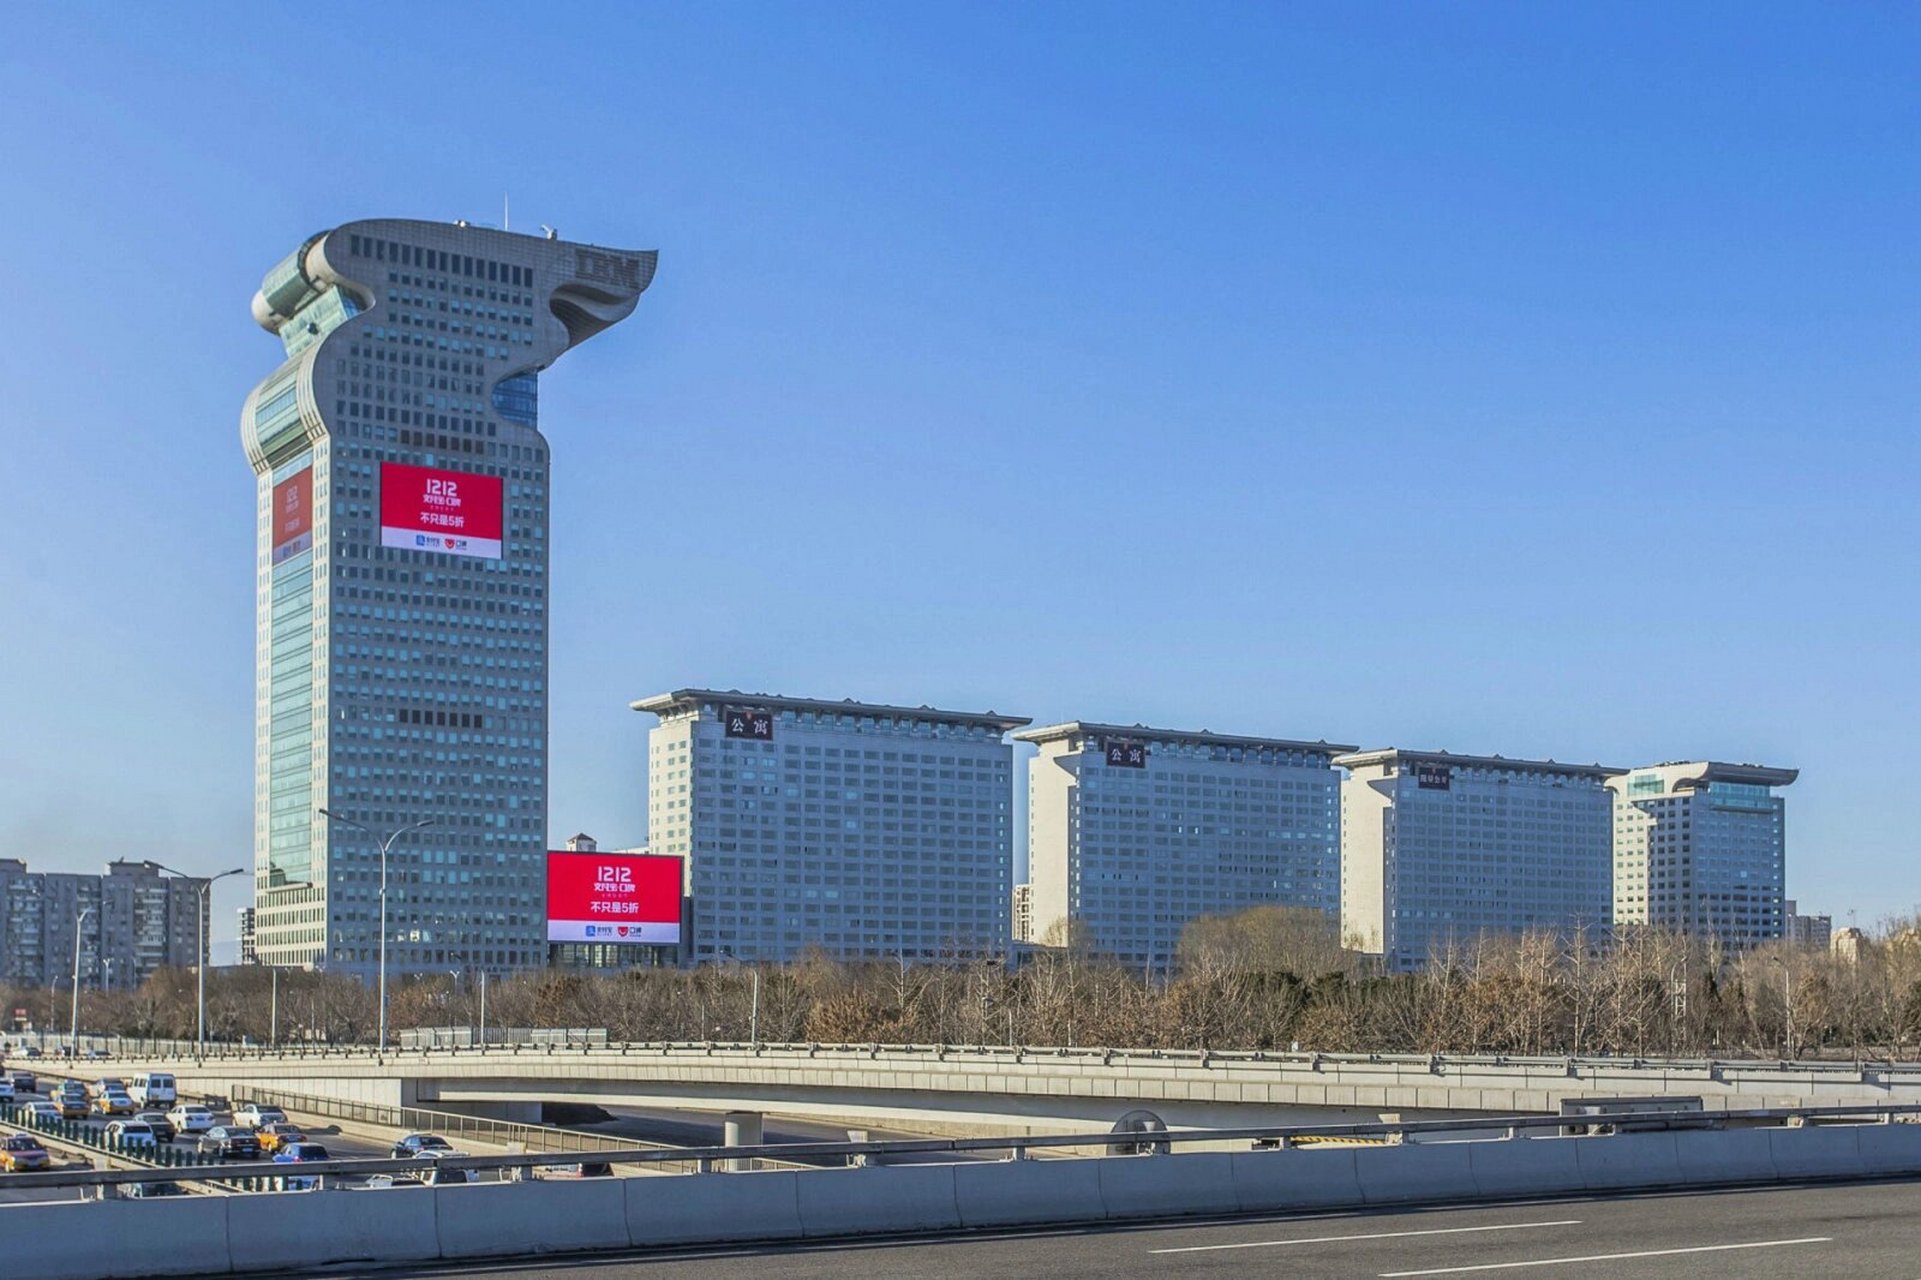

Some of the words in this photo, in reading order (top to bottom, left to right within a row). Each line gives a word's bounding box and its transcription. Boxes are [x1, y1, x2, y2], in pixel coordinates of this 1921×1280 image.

[576, 248, 641, 288] IBM
[426, 478, 458, 497] 1212
[420, 512, 465, 528] 不只是5折
[731, 718, 768, 735] 公寓
[597, 866, 632, 882] 1212
[590, 901, 639, 914] 不只是5折
